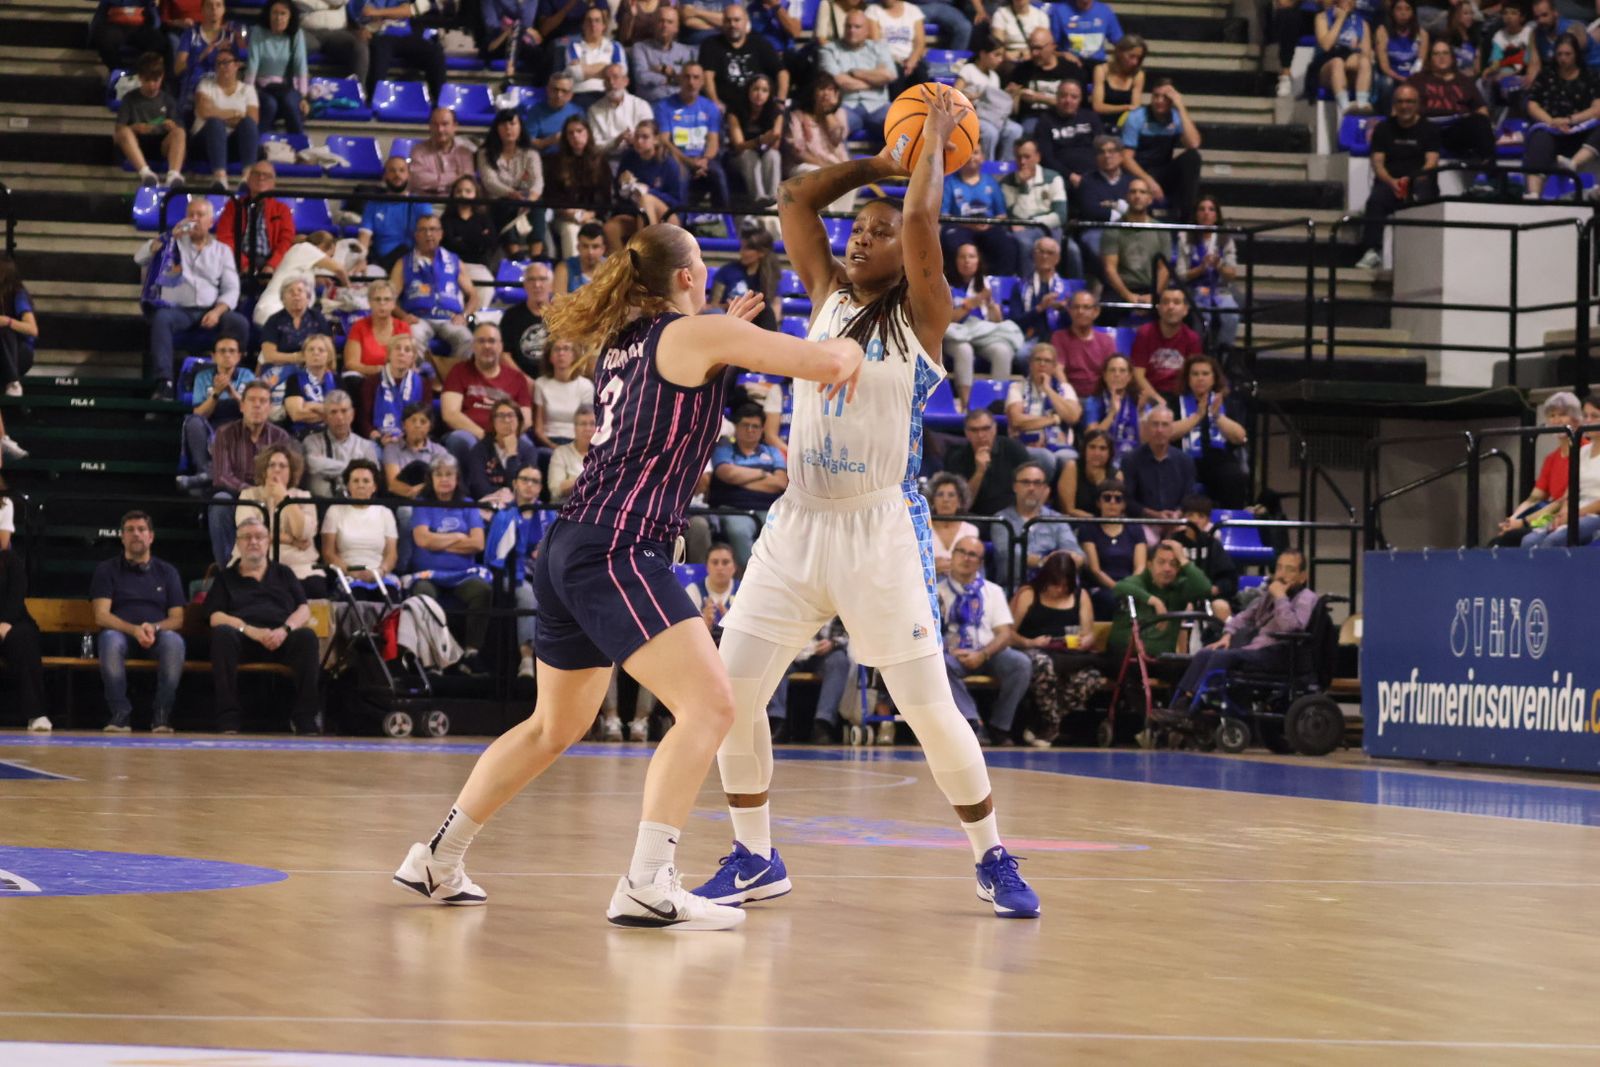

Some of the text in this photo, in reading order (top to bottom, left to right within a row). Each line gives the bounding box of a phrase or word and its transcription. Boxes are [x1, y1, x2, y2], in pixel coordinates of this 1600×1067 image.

[70, 398, 87, 406] FILA
[590, 374, 624, 446] 3
[81, 462, 98, 470] FILA
[98, 528, 117, 537] FILA
